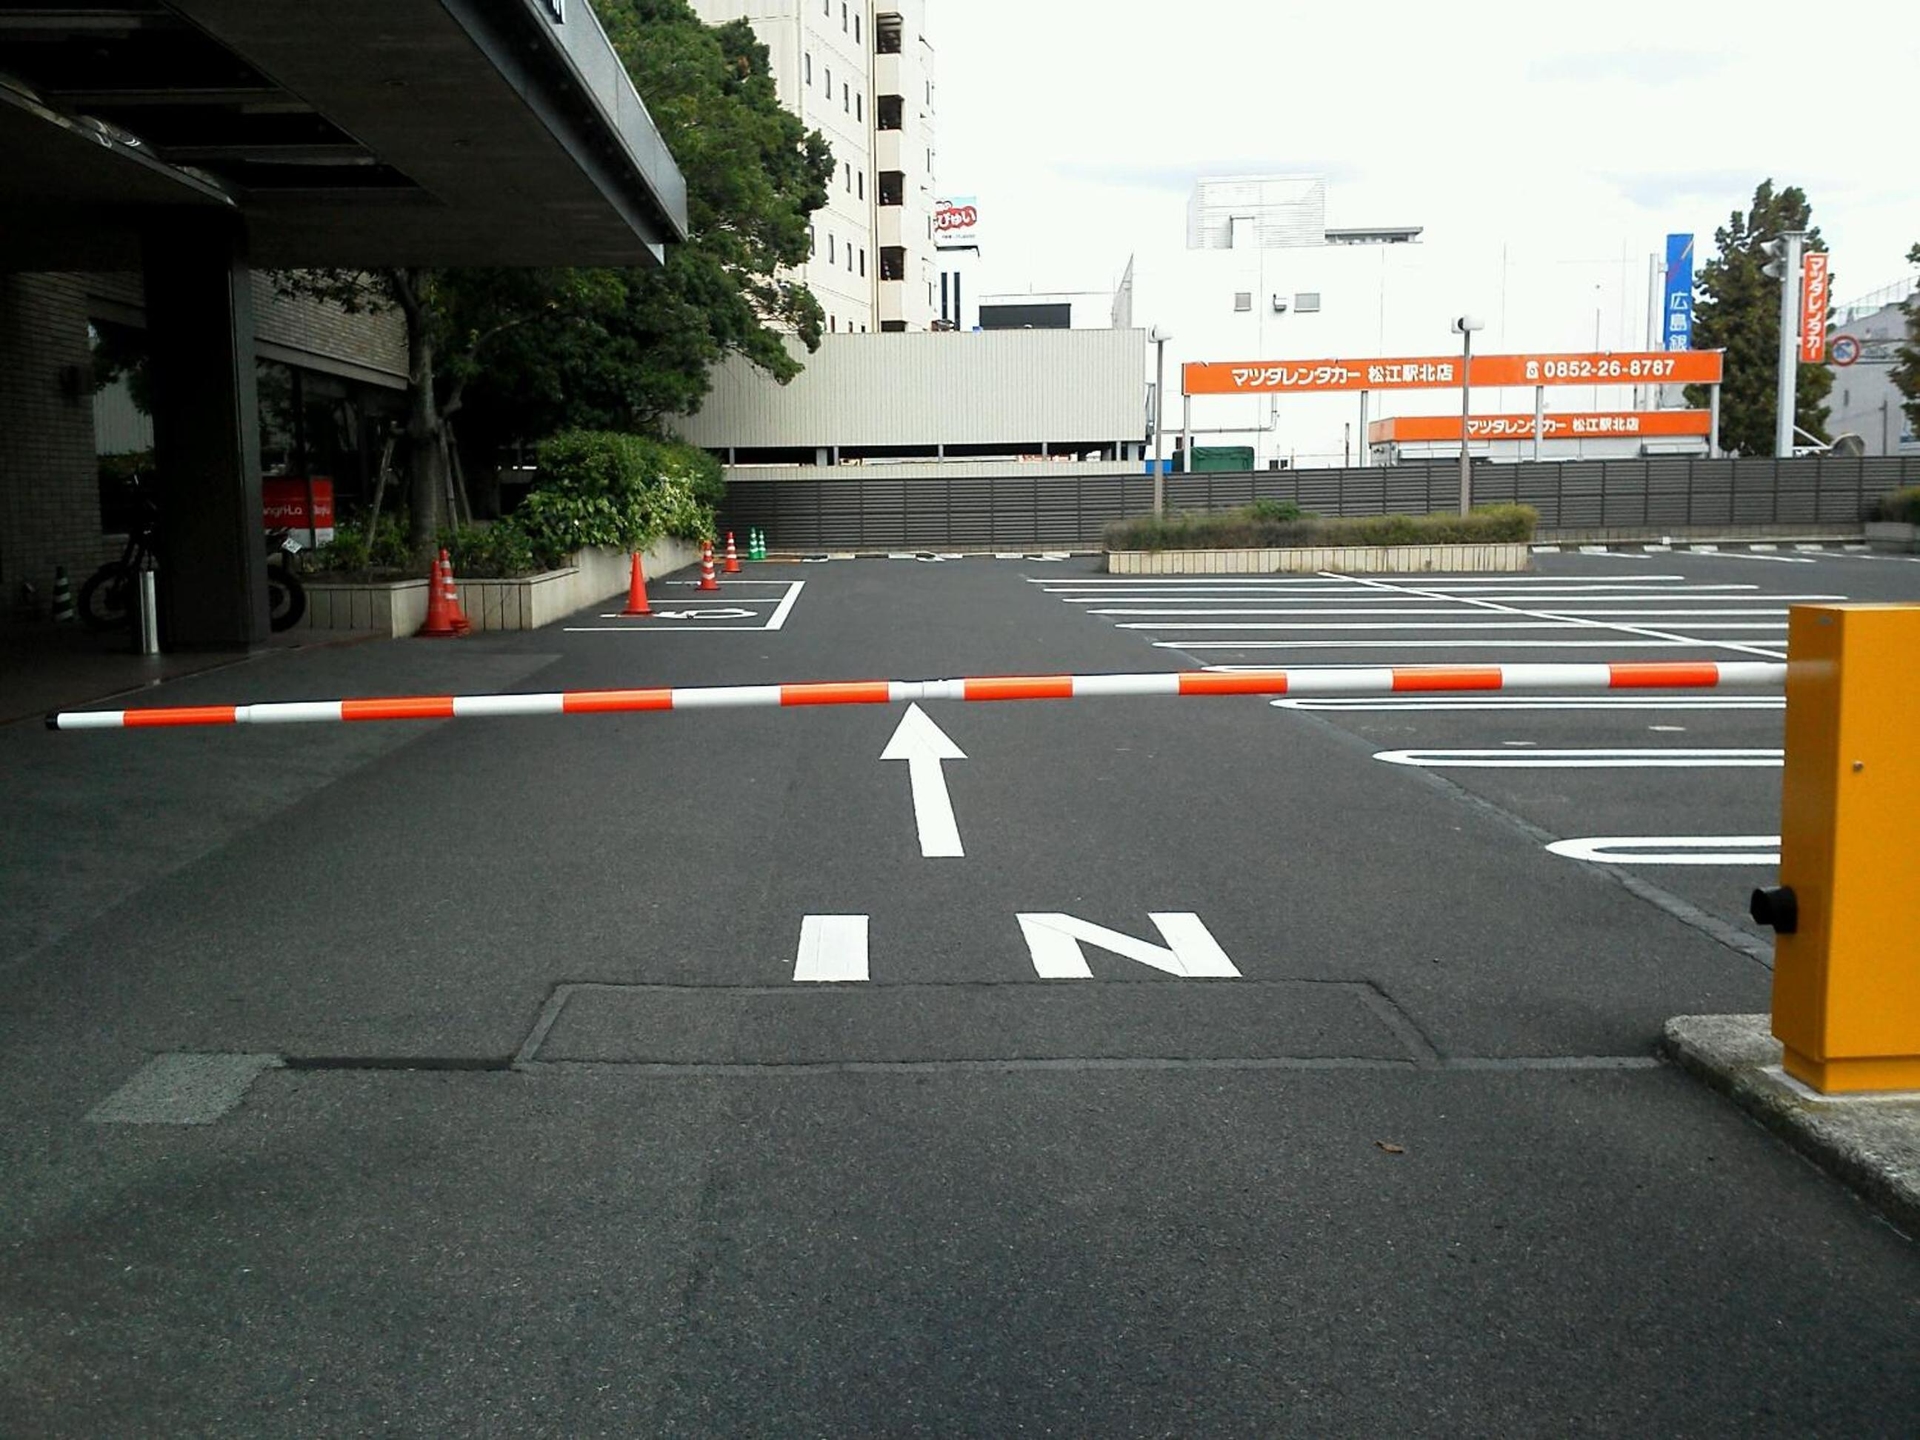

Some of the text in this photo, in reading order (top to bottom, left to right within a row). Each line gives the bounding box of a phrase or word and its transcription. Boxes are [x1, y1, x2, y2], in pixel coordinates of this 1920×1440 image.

[1808, 257, 1825, 359] マツダレンタカー
[1231, 363, 1454, 387] マツダレンタカー 松江駅北店
[1543, 359, 1675, 378] 0852-26-8787
[1572, 416, 1640, 432] 松江駅北店
